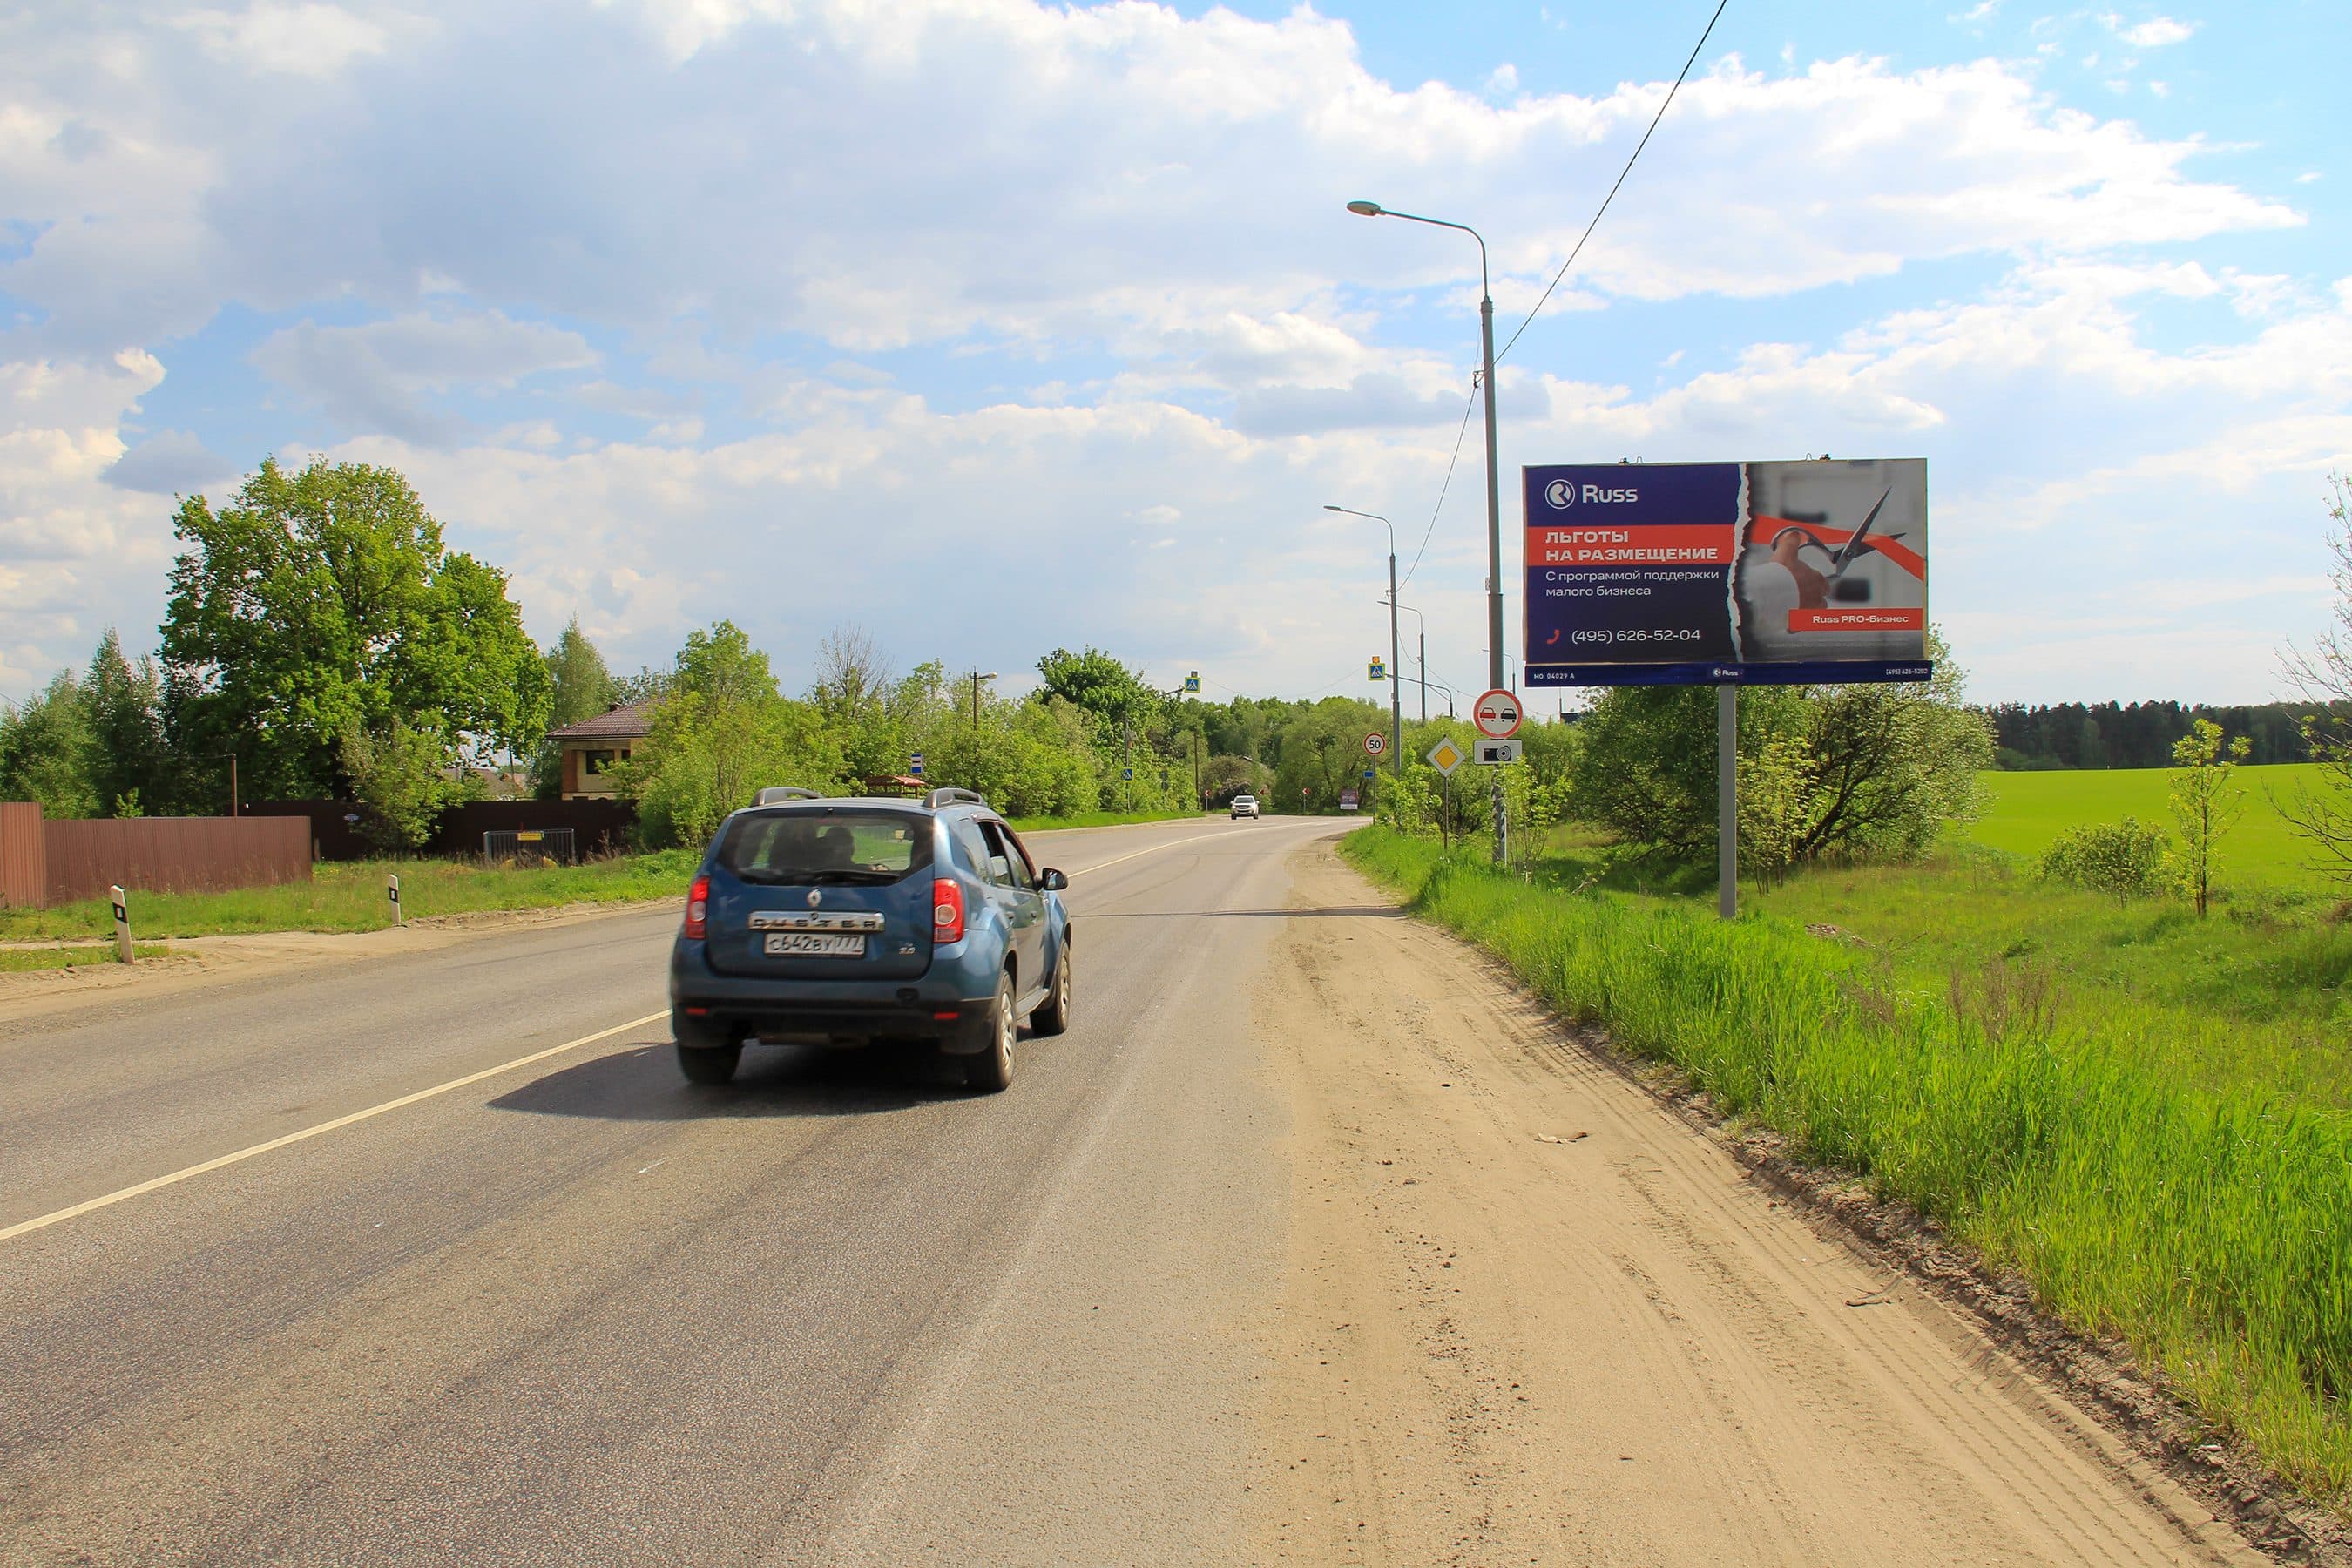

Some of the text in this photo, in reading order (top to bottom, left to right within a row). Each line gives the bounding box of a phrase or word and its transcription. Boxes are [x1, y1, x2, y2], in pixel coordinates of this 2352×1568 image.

[1582, 484, 1638, 504] Russ
[1545, 531, 1629, 544] ЛЬГОТЫ
[1545, 548, 1718, 562] НА РАЗМЕЩЕНИЕ
[1545, 570, 1720, 583] С программой поддержки
[1545, 585, 1652, 597] малого бизнеса
[1812, 614, 1909, 624] Russ PRO-Бизнес
[1571, 629, 1701, 645] (495) 626-52-04
[1369, 740, 1381, 749] 50
[753, 917, 876, 929] DUSTER
